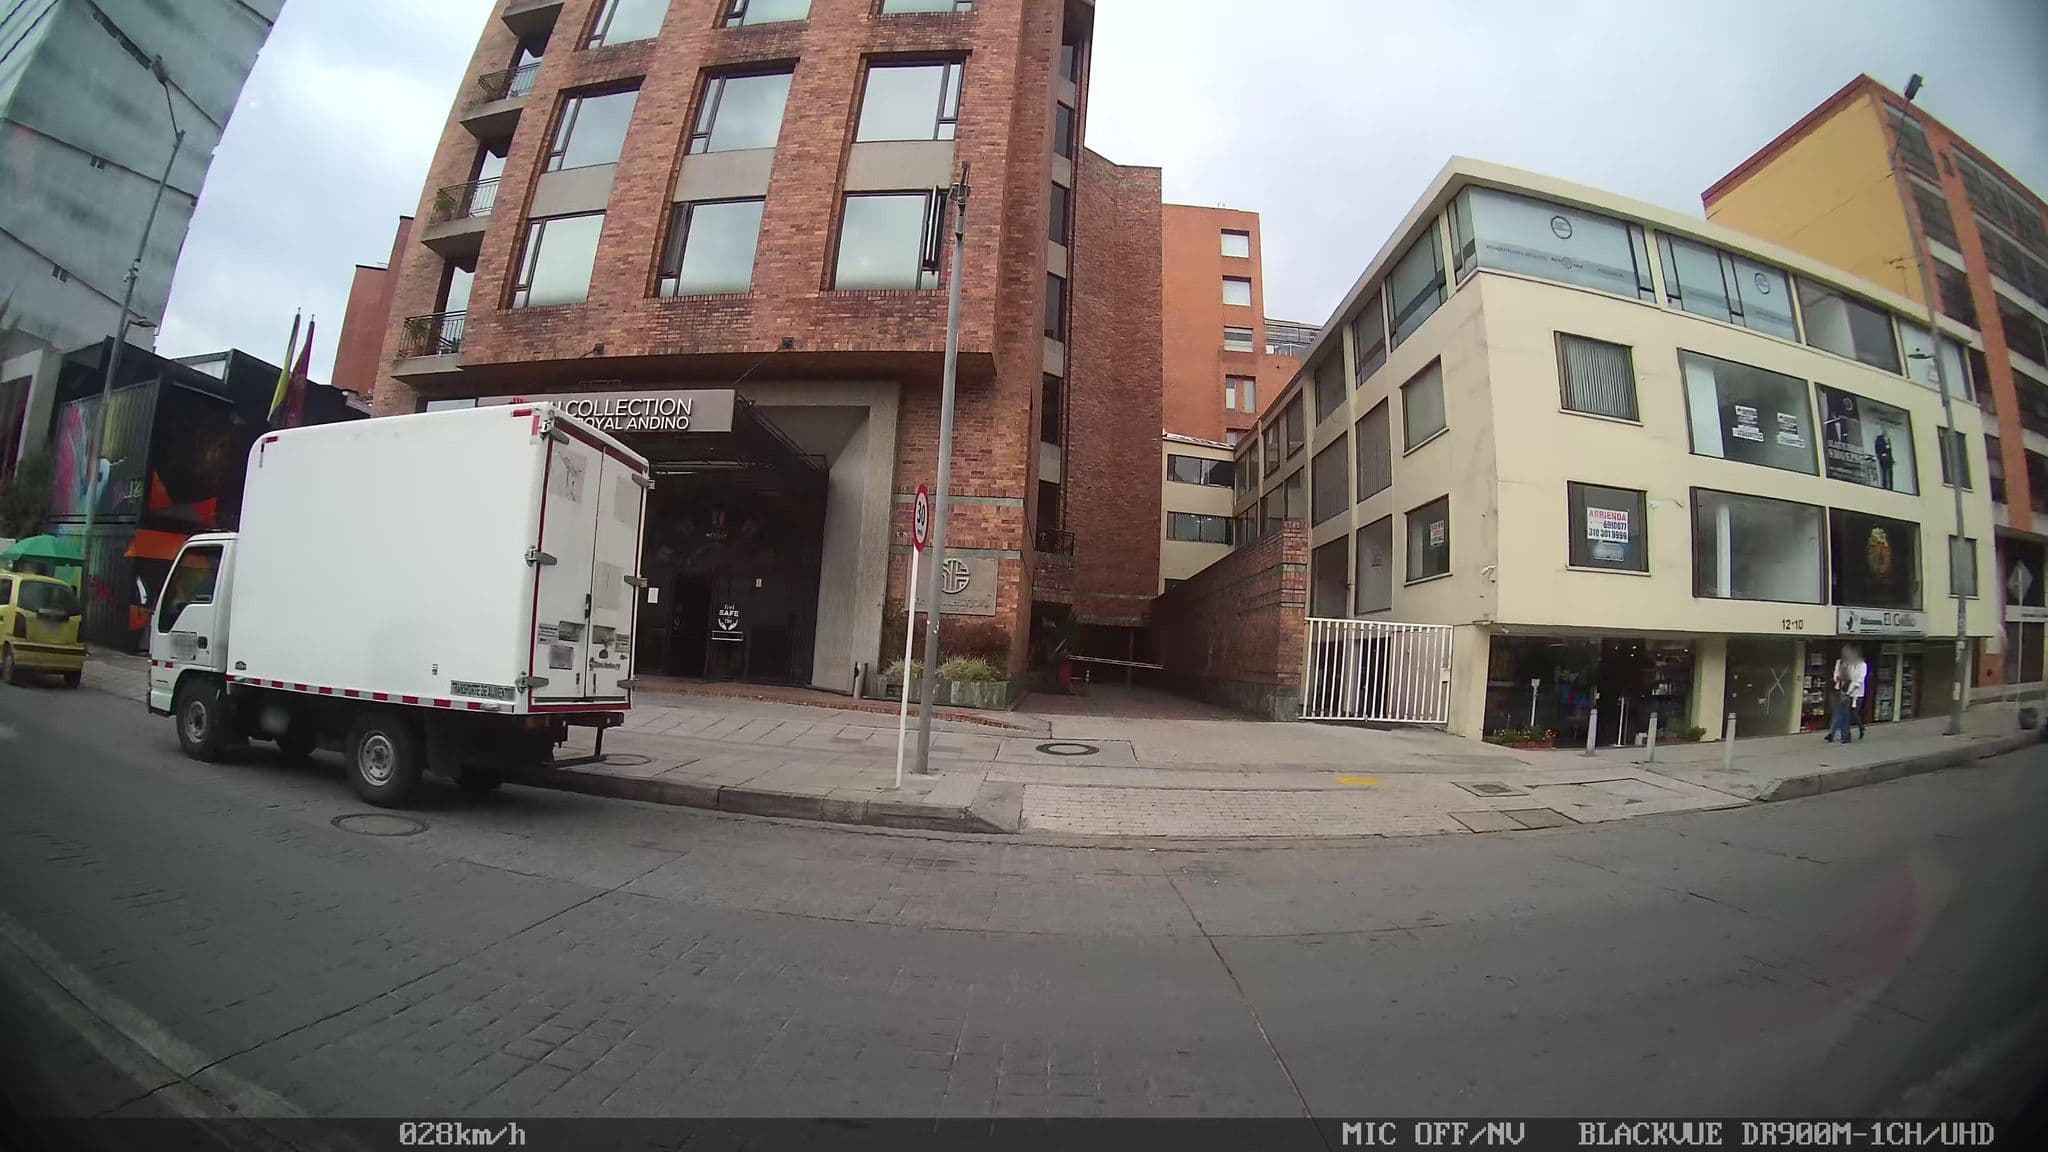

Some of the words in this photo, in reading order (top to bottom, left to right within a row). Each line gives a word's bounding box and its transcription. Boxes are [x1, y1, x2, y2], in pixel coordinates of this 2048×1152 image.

[566, 397, 692, 417] COLLECTION
[626, 416, 689, 430] ANDINO
[1589, 510, 1627, 521] ARRIENDA
